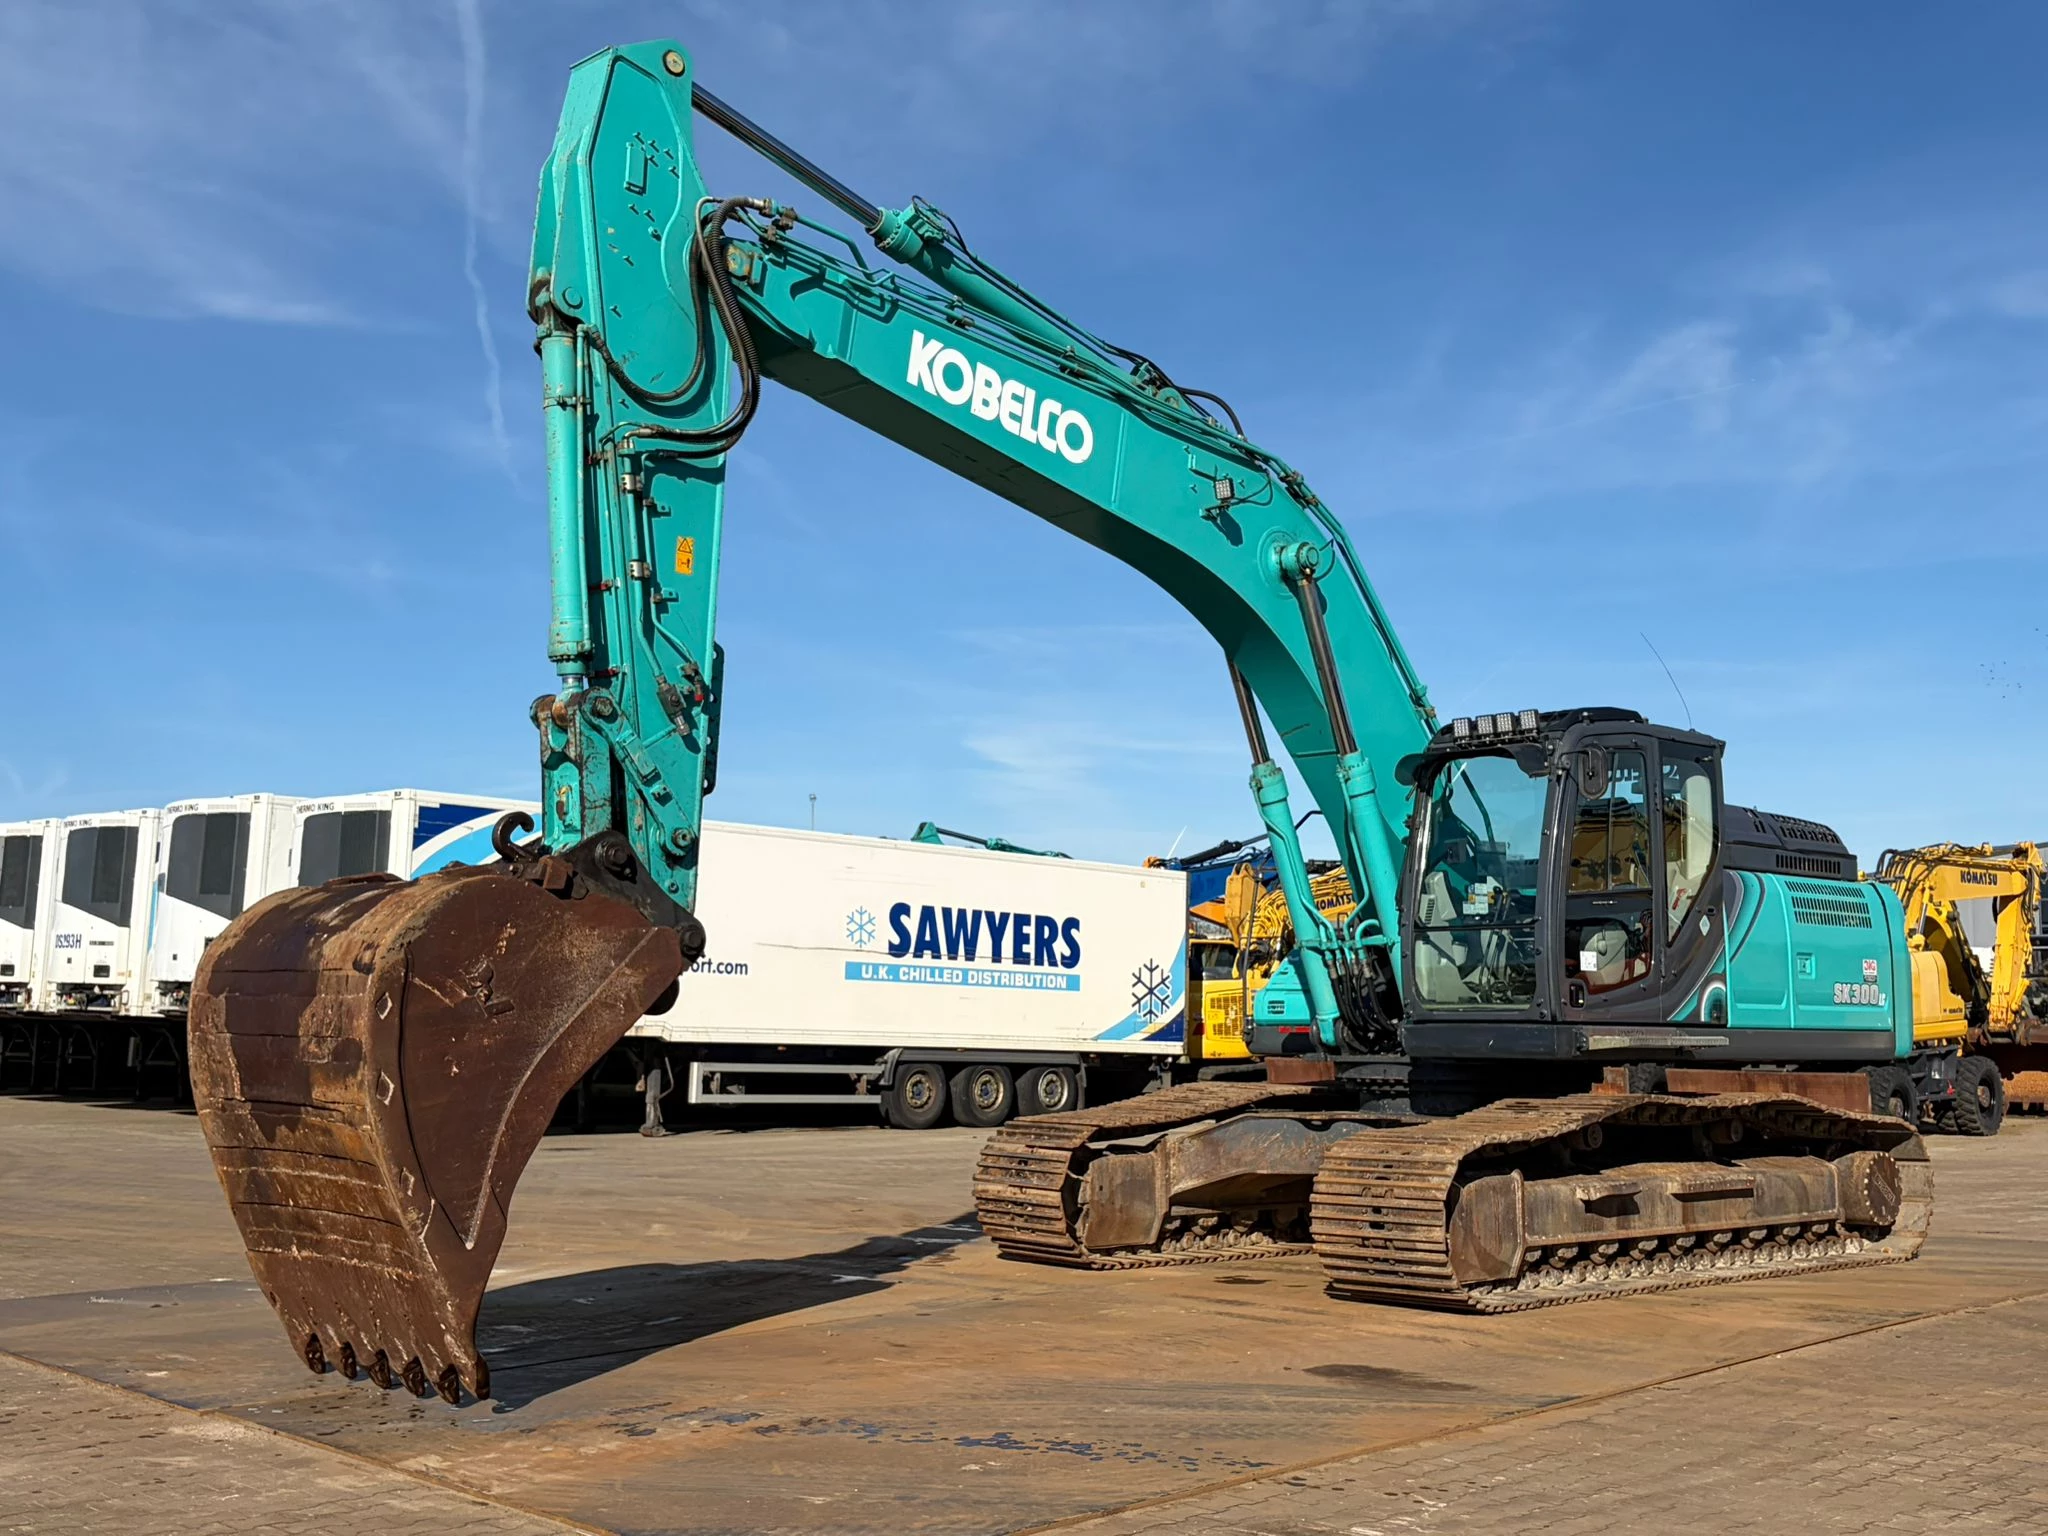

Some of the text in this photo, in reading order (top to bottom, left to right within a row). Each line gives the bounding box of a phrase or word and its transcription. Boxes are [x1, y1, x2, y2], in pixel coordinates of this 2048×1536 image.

[906, 329, 1094, 464] KOBELCO
[1960, 868, 1998, 886] KOMATSU
[888, 902, 1081, 969] SAWYERS
[691, 958, 748, 975] ort.com
[861, 964, 1067, 989] U.K. CHILLED DISTRIBUTION
